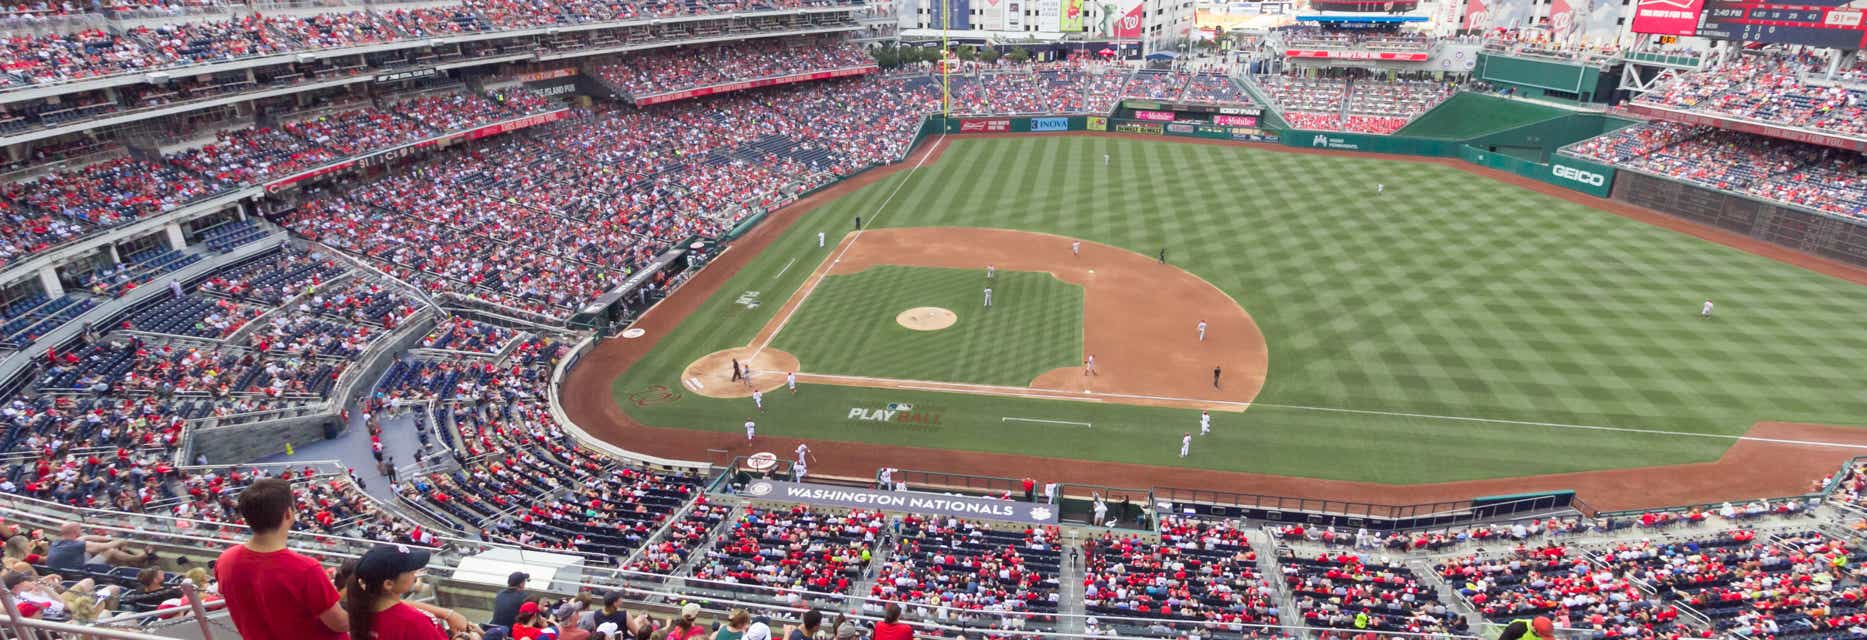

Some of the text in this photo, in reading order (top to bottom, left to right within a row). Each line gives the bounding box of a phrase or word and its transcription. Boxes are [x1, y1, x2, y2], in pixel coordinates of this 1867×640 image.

[1040, 118, 1067, 129] INOVA
[1552, 164, 1604, 187] GEICO
[847, 407, 896, 421] PLAY
[787, 487, 906, 507] WASHINGTON
[910, 497, 1014, 516] NATIONALS
